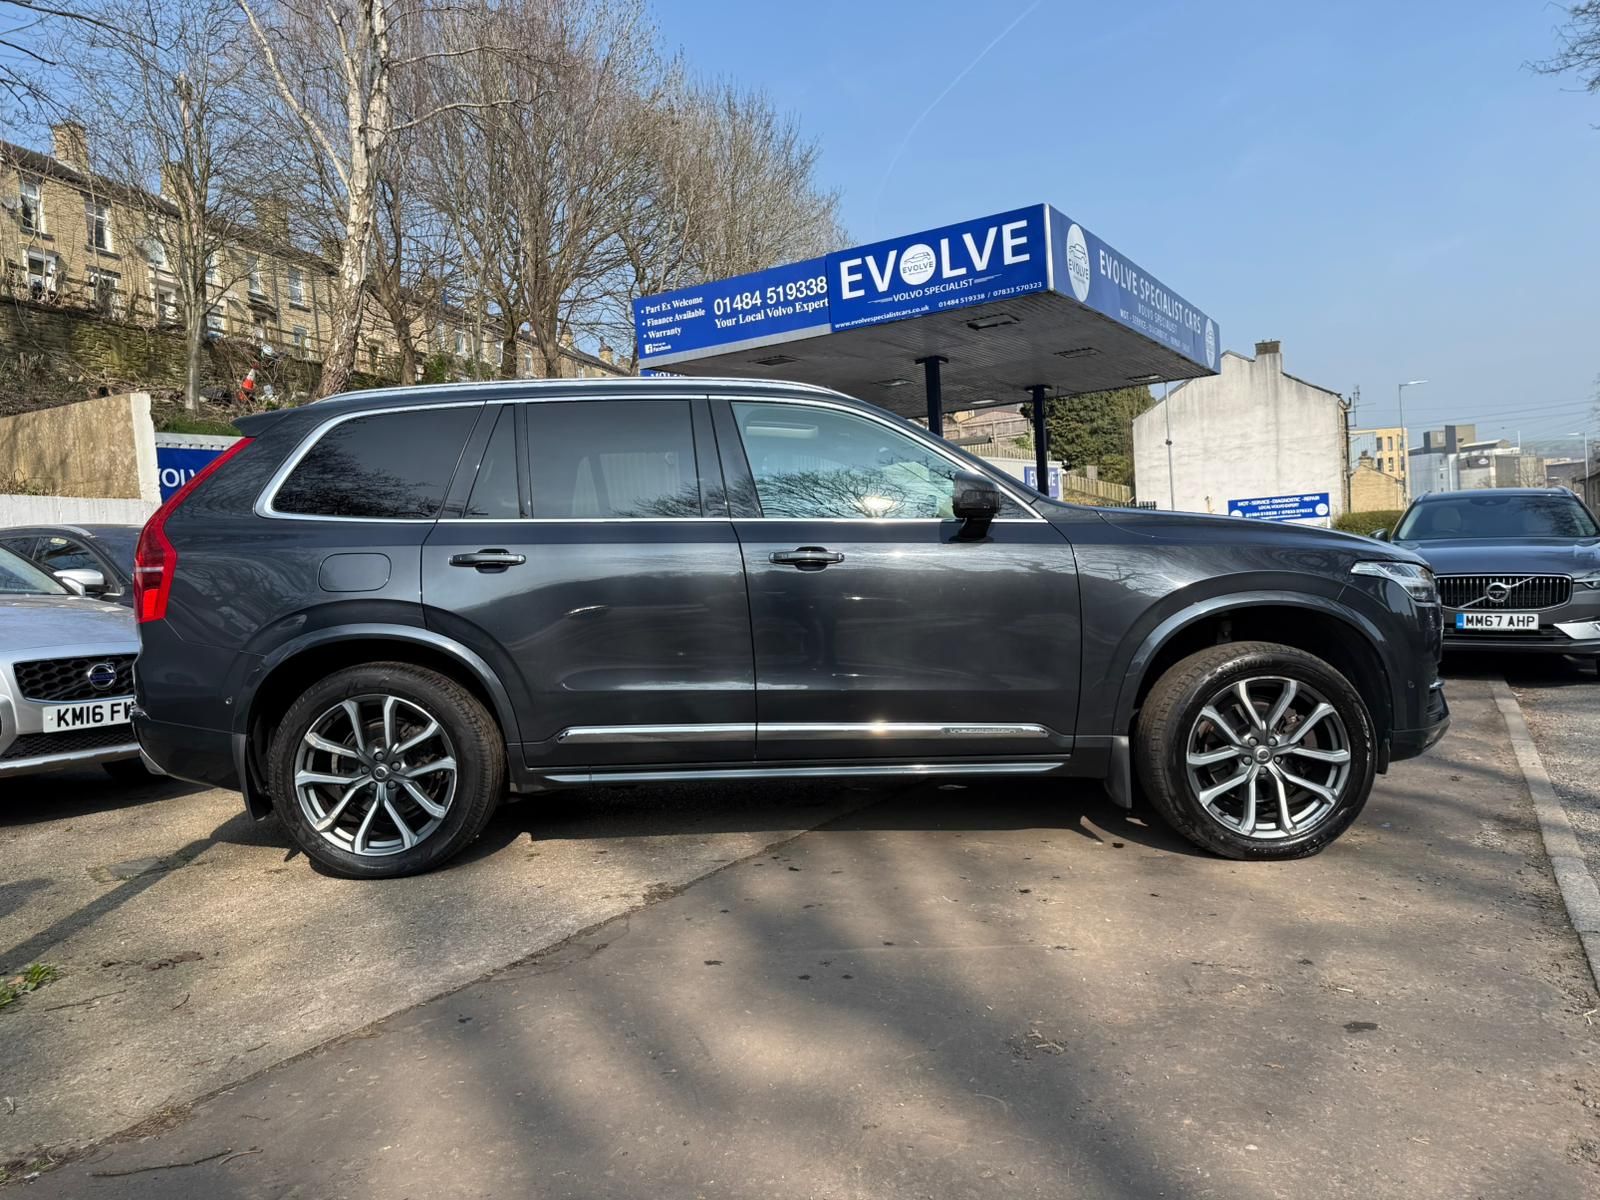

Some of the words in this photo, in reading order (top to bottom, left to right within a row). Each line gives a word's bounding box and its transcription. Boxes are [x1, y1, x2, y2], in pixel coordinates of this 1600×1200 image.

[840, 220, 1030, 300] EVOLVE
[902, 261, 933, 274] EVOLVE
[1069, 259, 1088, 279] EVOLVE
[714, 290, 762, 315] 01484
[766, 276, 827, 304] 519338
[893, 290, 923, 302] VOLVO
[924, 278, 974, 296] SPECIALIST
[938, 299, 959, 307] 01484
[960, 294, 985, 304] 519338
[993, 288, 1014, 297] 07833
[1016, 282, 1042, 292] 570323
[1100, 249, 1137, 295] EVOLVE
[1140, 278, 1182, 323] SPECIALIST
[1185, 308, 1200, 334] CARS
[645, 306, 660, 314] Part
[662, 302, 671, 311] Ex
[672, 297, 703, 308] Welcome
[715, 317, 737, 328] Your
[739, 310, 764, 324] Local
[766, 306, 793, 318] Volvo
[795, 298, 829, 313] Expert
[835, 304, 929, 328] www.evolvespecialistcars.co.uk
[647, 316, 673, 327] Finance
[674, 309, 706, 321] Available
[648, 327, 682, 339] Warranty
[1466, 615, 1502, 626] MM67
[1508, 616, 1535, 627] AHP
[57, 705, 104, 728] KM16
